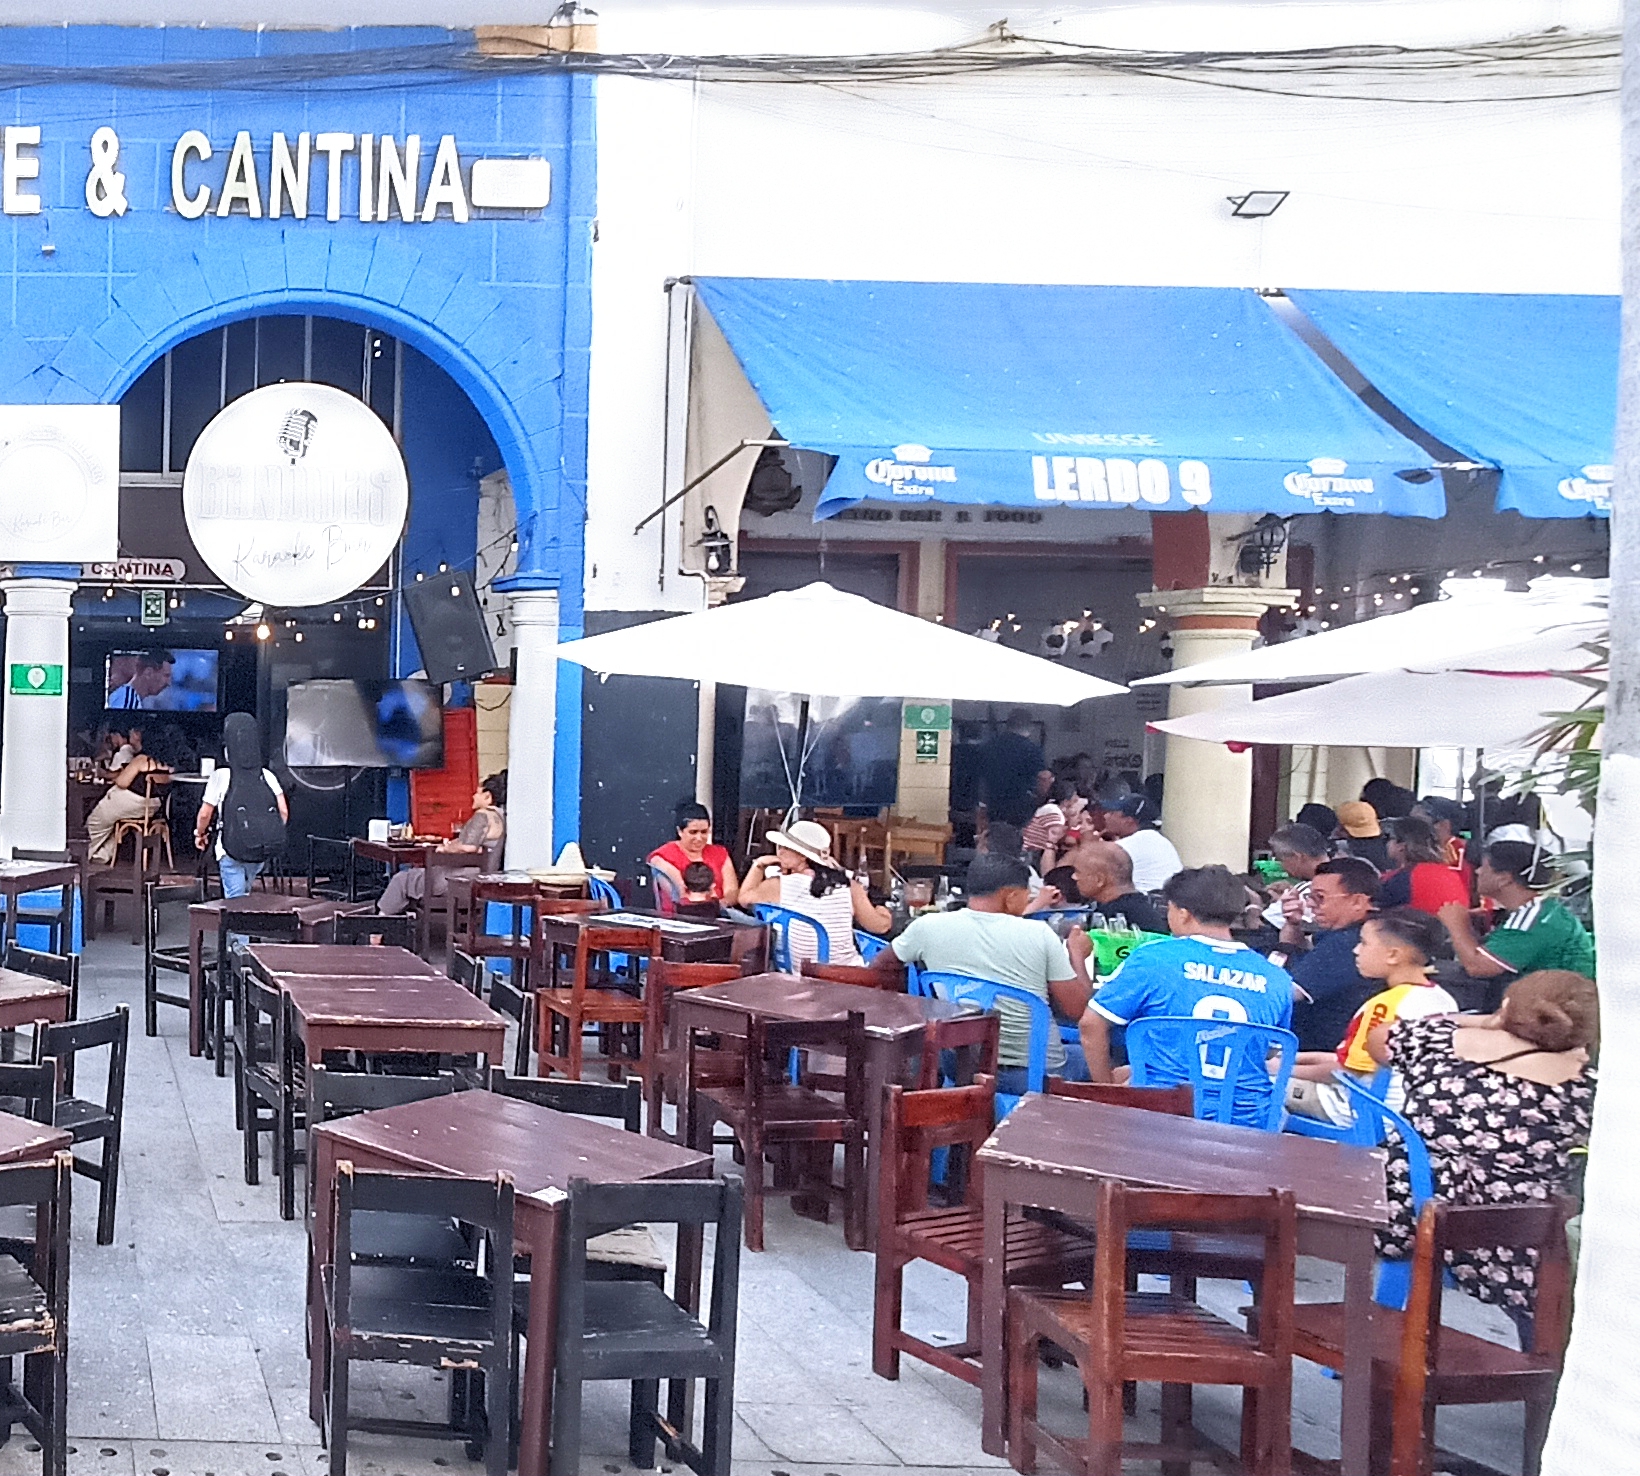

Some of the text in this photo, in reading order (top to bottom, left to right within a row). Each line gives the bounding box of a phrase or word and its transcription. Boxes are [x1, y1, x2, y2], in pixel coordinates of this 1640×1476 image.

[84, 126, 128, 218] &
[171, 130, 470, 223] CANTINA
[865, 459, 958, 486] Corona
[1031, 455, 1212, 505] LERDO 9
[1283, 471, 1375, 498] Corona
[1183, 961, 1267, 993] SALAZAR
